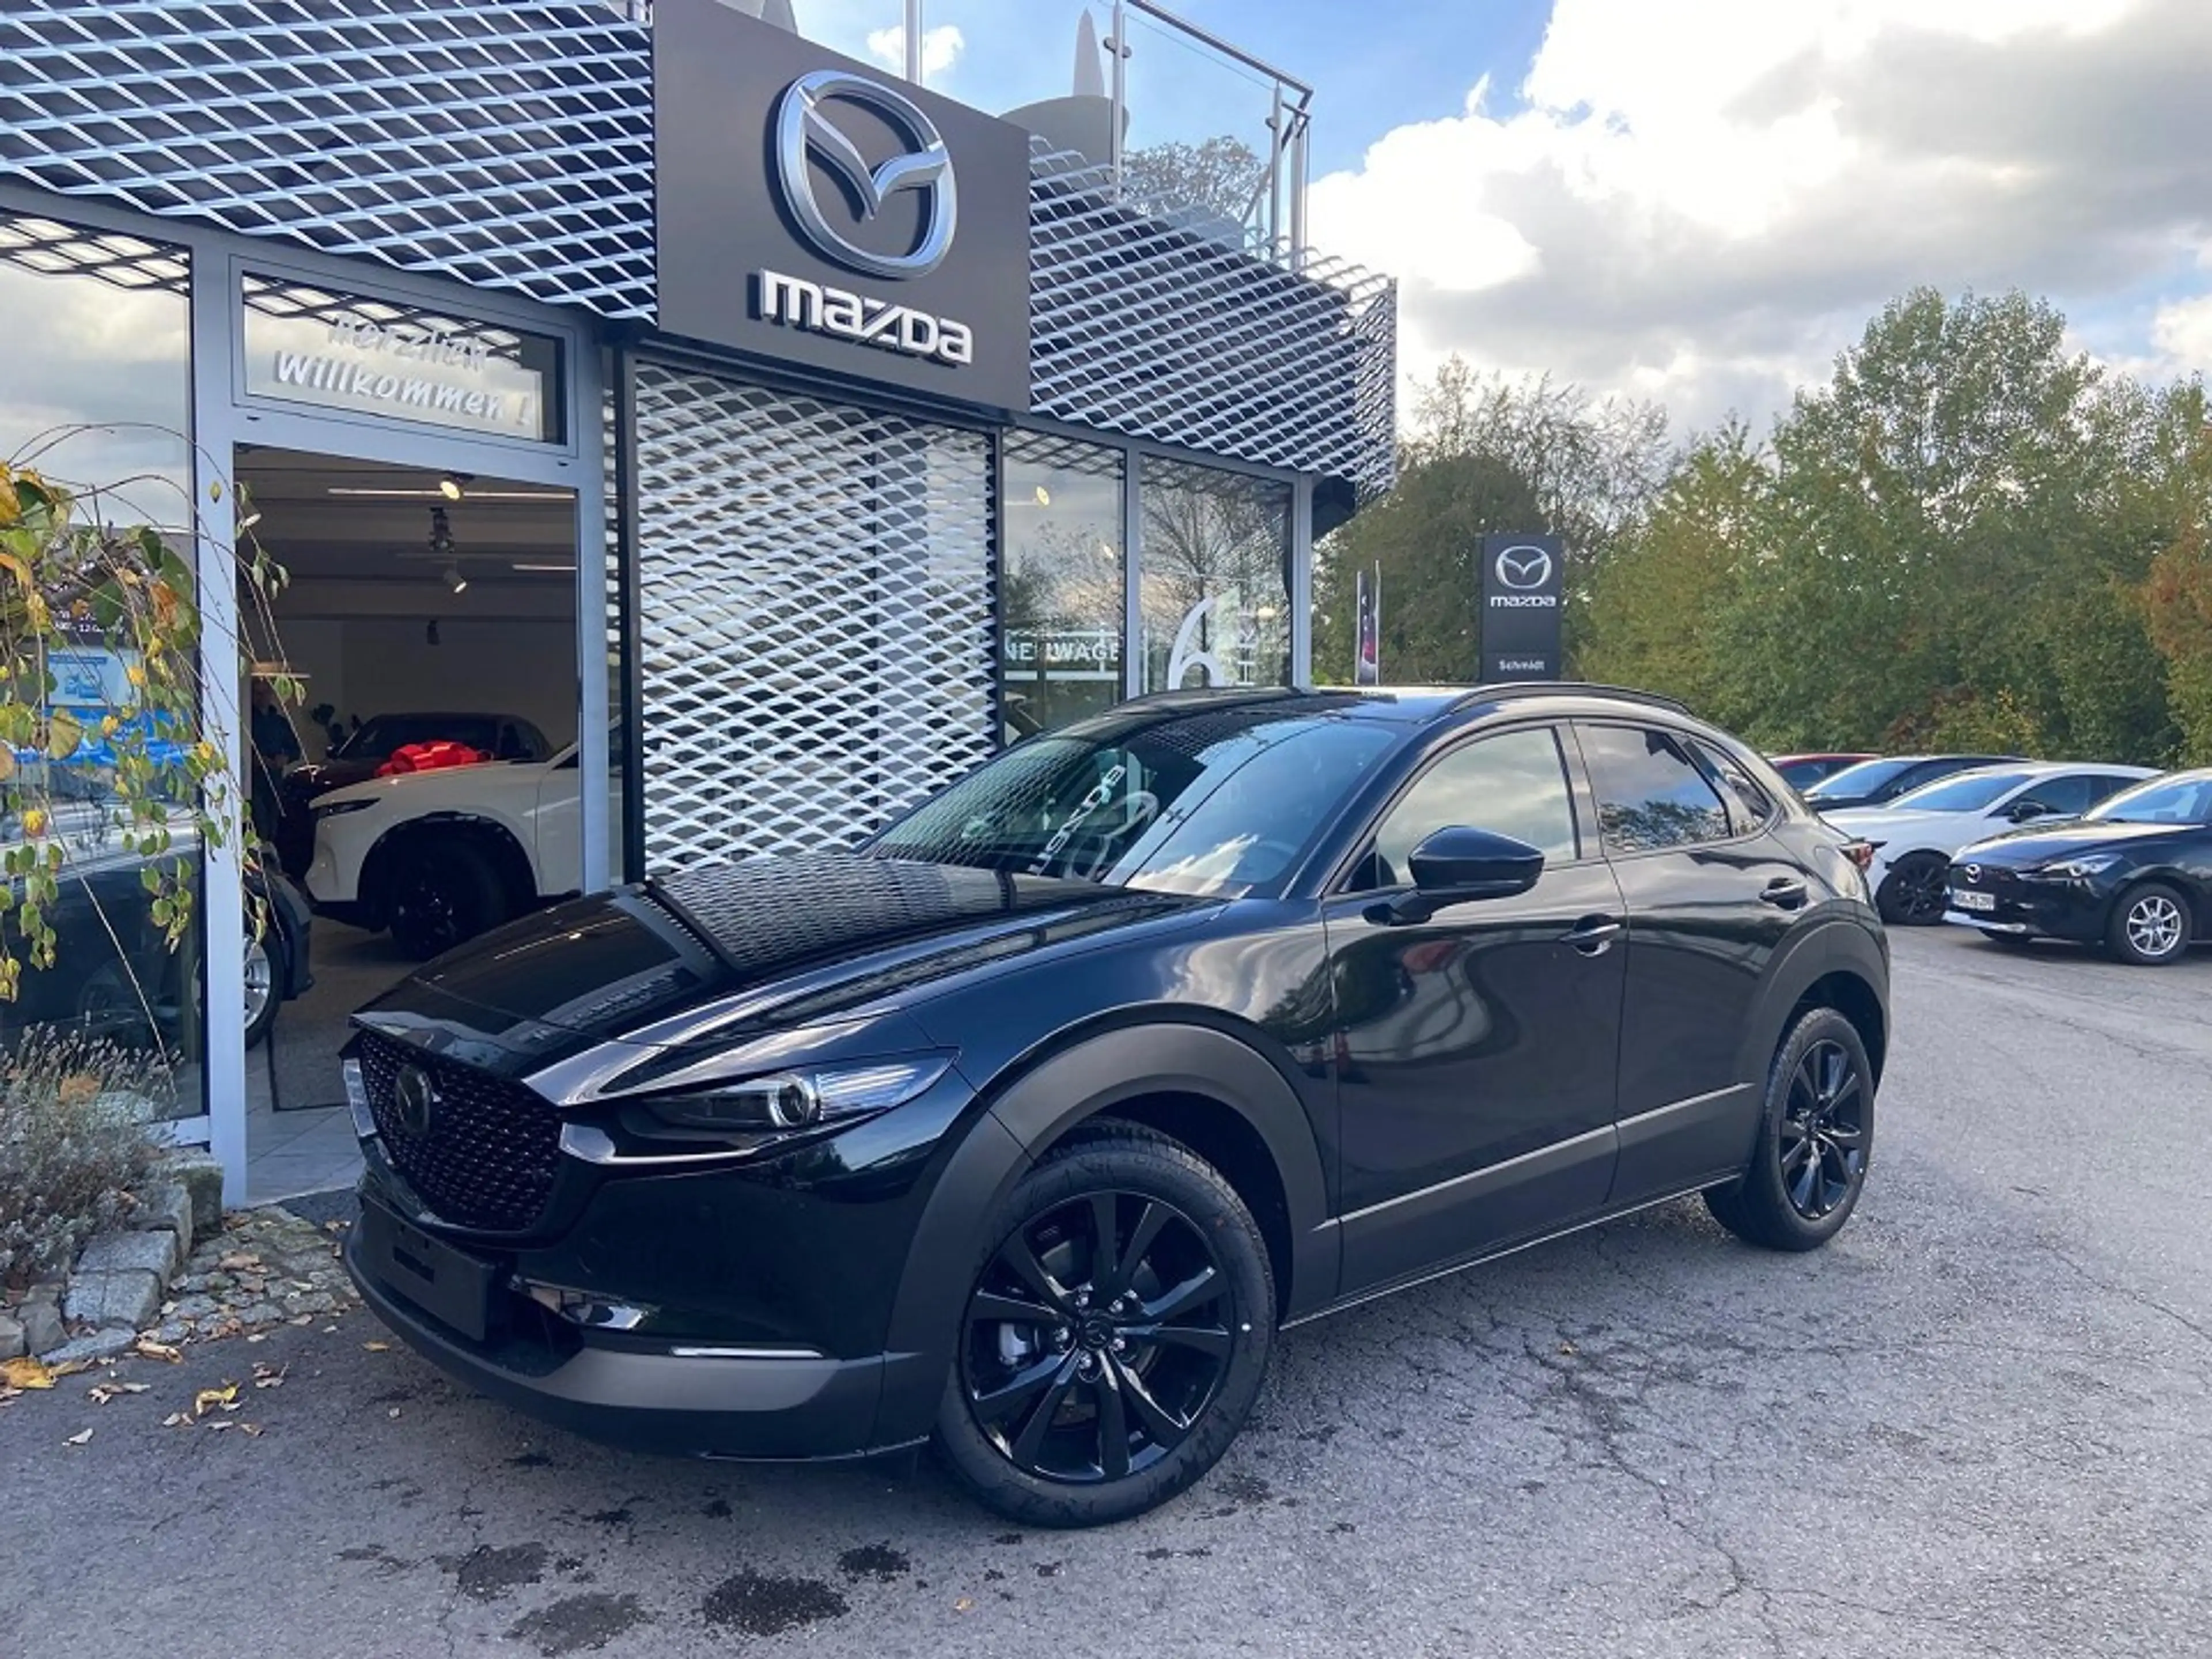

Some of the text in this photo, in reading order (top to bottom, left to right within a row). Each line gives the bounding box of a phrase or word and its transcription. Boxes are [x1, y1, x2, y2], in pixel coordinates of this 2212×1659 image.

[760, 268, 972, 364] mazda
[276, 350, 505, 419] Willkommen
[1490, 596, 1556, 607] mazda
